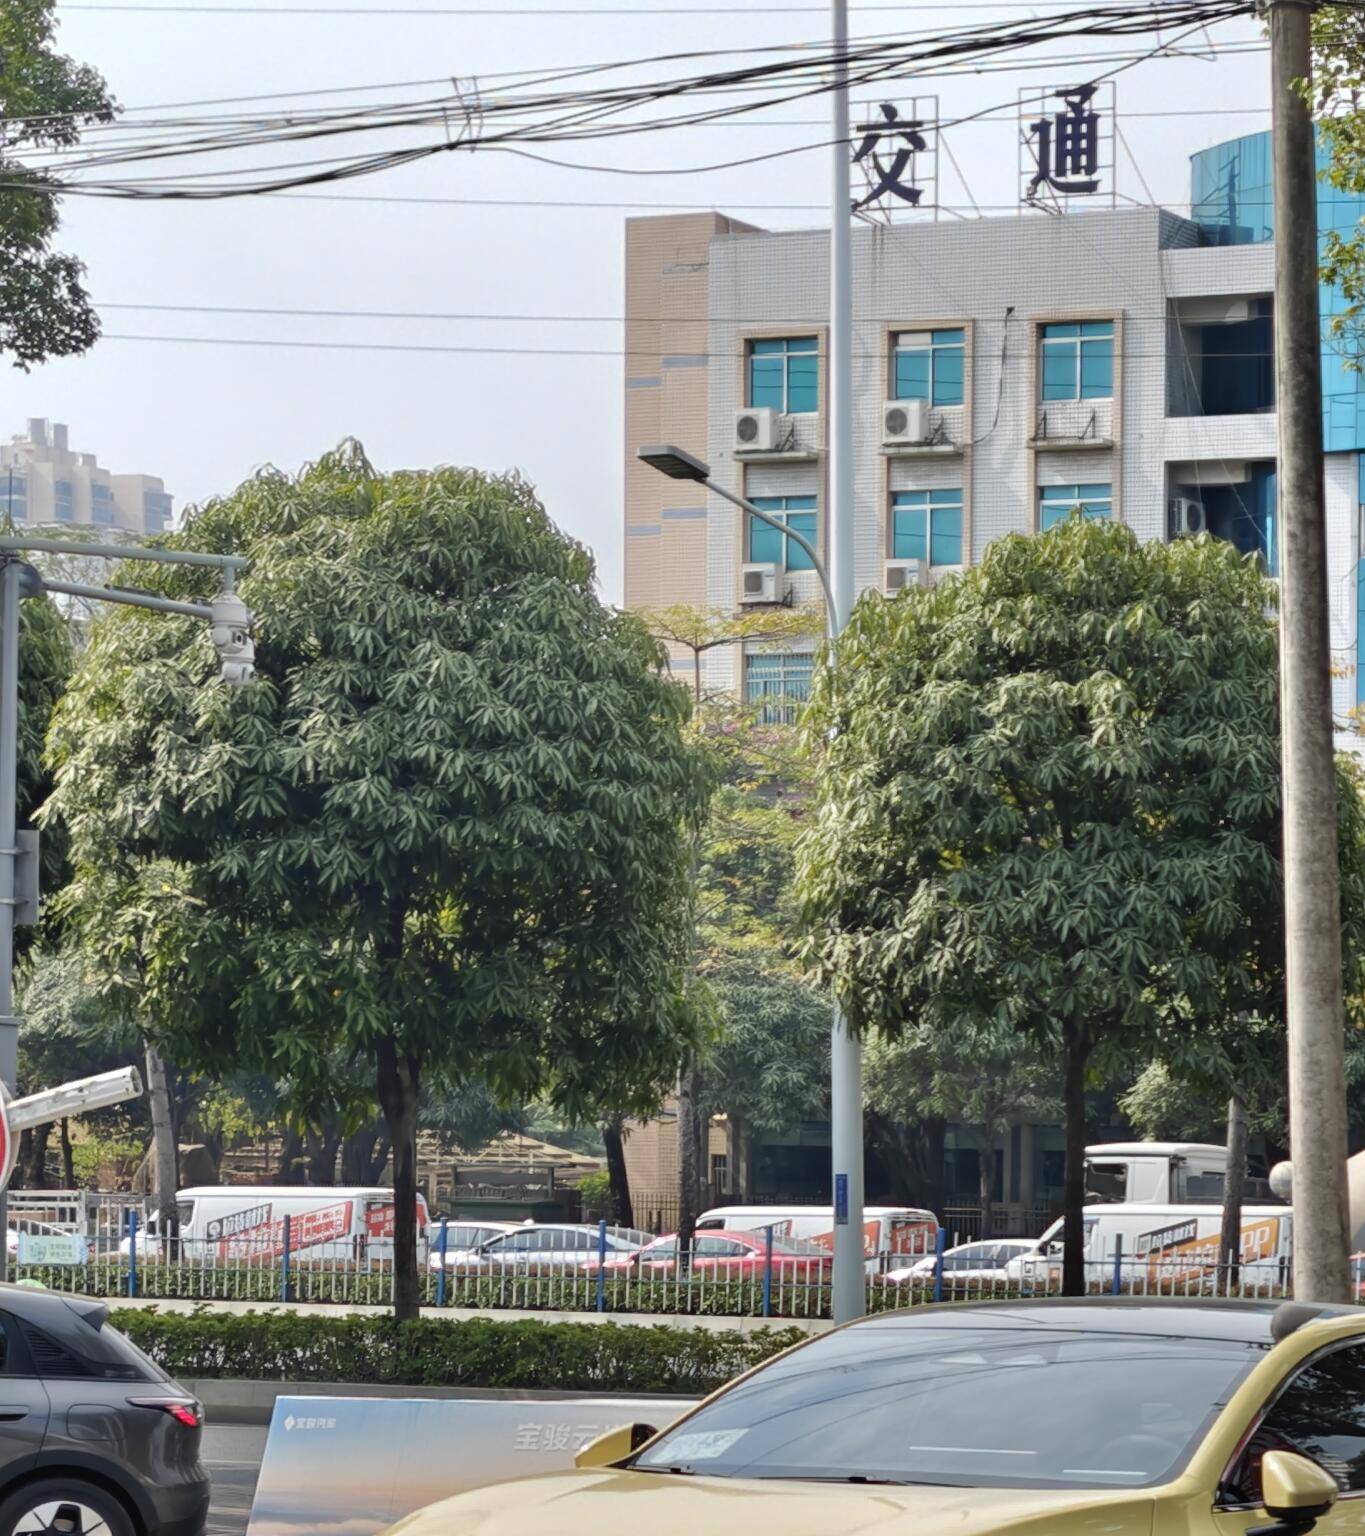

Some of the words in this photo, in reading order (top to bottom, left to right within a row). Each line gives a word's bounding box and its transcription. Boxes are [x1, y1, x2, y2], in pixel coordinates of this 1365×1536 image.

[851, 86, 1102, 210] 交通
[512, 1422, 617, 1452] 宝骏云
